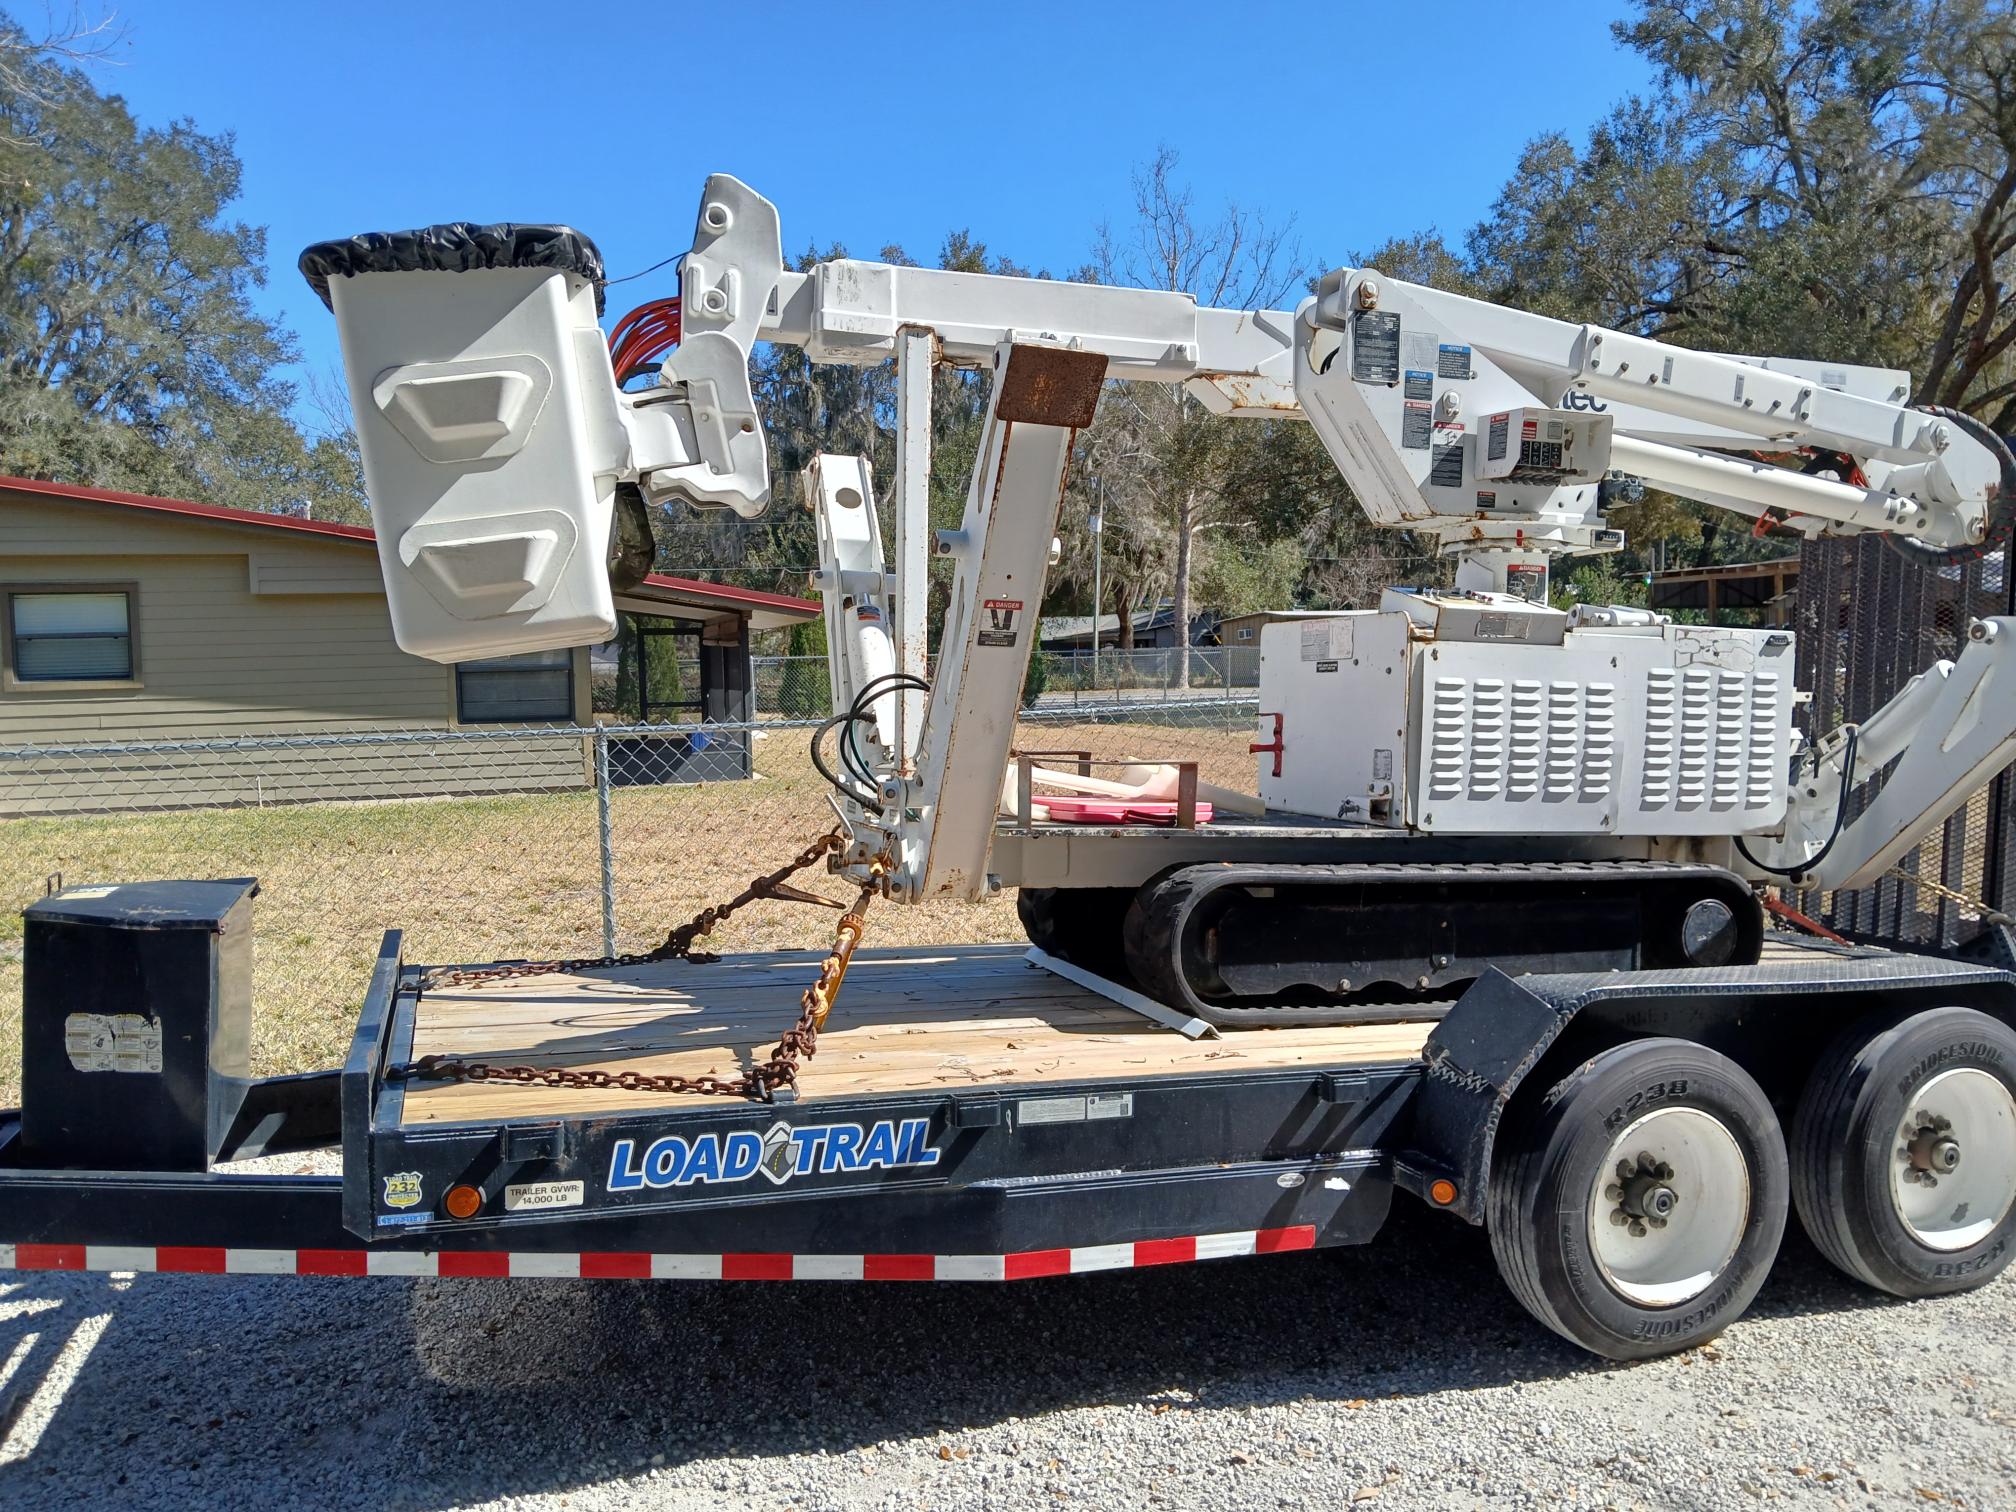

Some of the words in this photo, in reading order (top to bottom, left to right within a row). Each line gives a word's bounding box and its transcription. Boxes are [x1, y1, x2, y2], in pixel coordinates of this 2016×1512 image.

[1555, 390, 1608, 412] tec
[1897, 1041, 2006, 1098] BRIDGESTONE
[1603, 1079, 1689, 1131] R238
[607, 1131, 765, 1191] LOAD
[788, 1118, 943, 1175] TRAIL
[510, 1186, 547, 1196] TRAILER
[551, 1184, 580, 1194] GVWR:
[523, 1195, 553, 1205] 14,000
[556, 1194, 567, 1202] LB
